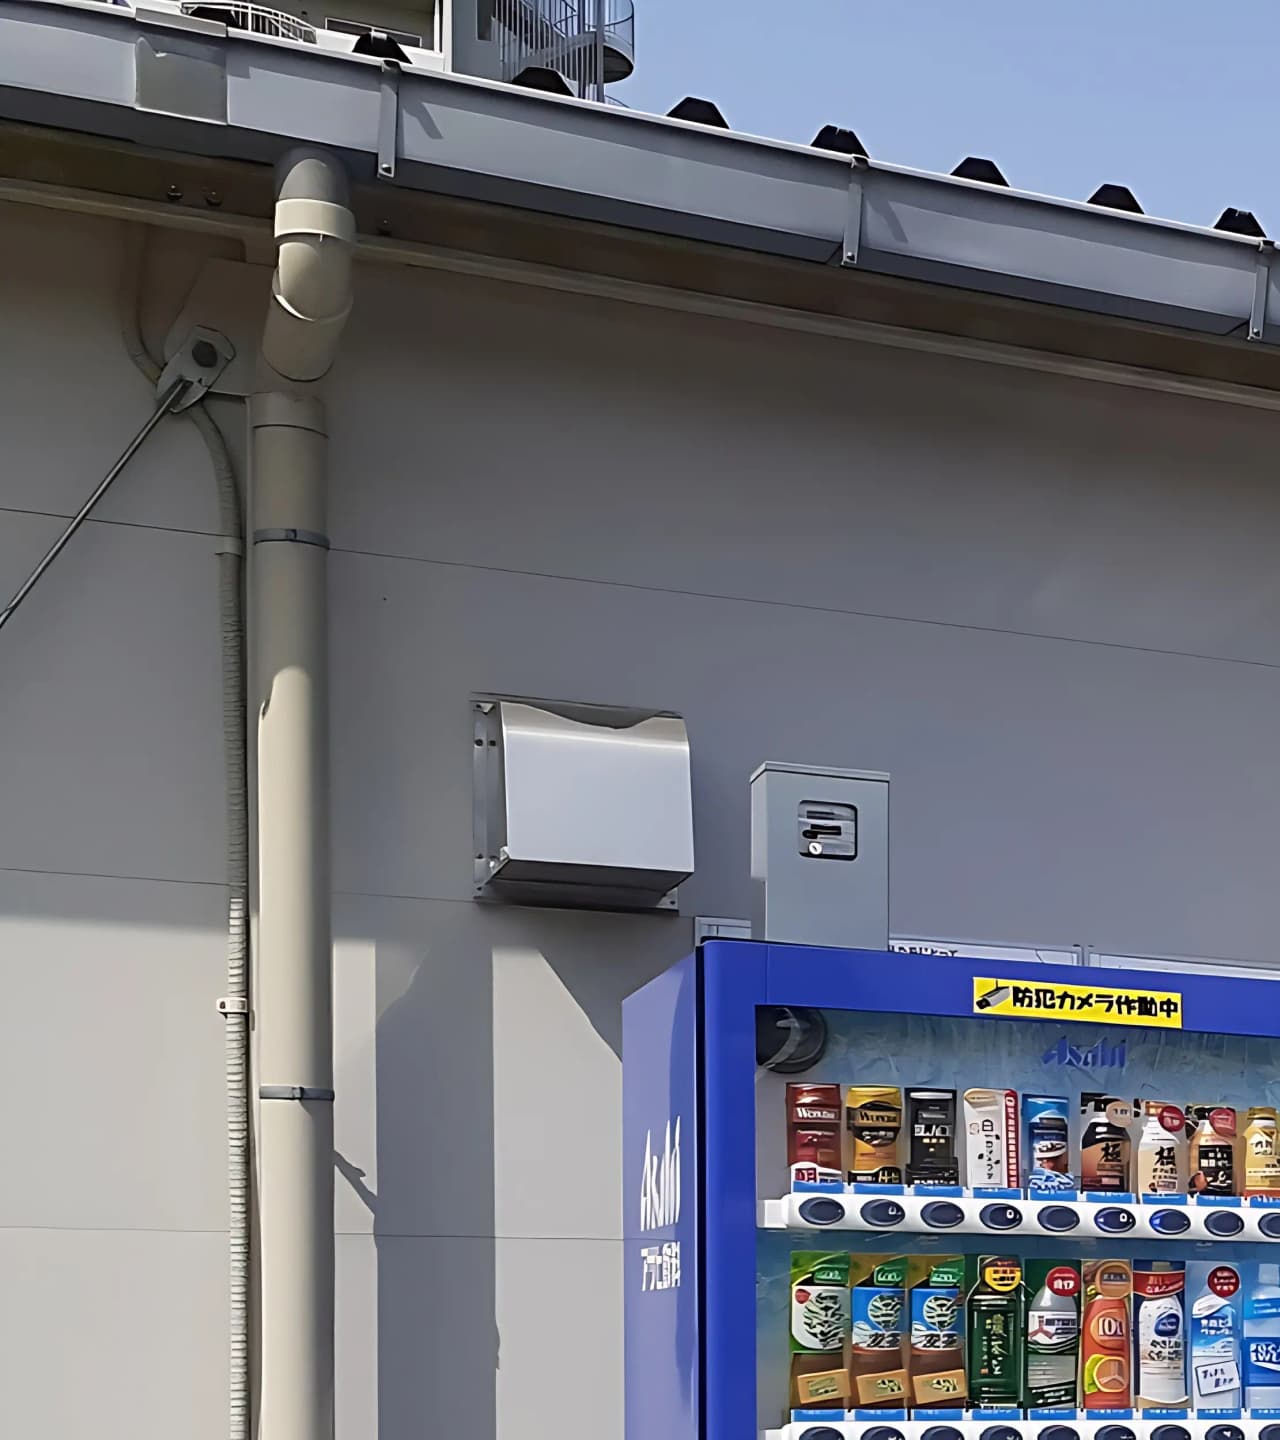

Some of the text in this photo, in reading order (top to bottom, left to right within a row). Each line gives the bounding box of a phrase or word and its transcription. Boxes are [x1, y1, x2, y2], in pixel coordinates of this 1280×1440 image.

[1012, 985, 1178, 1018] 防犯カメラ作動中
[640, 1115, 681, 1232] Asahi
